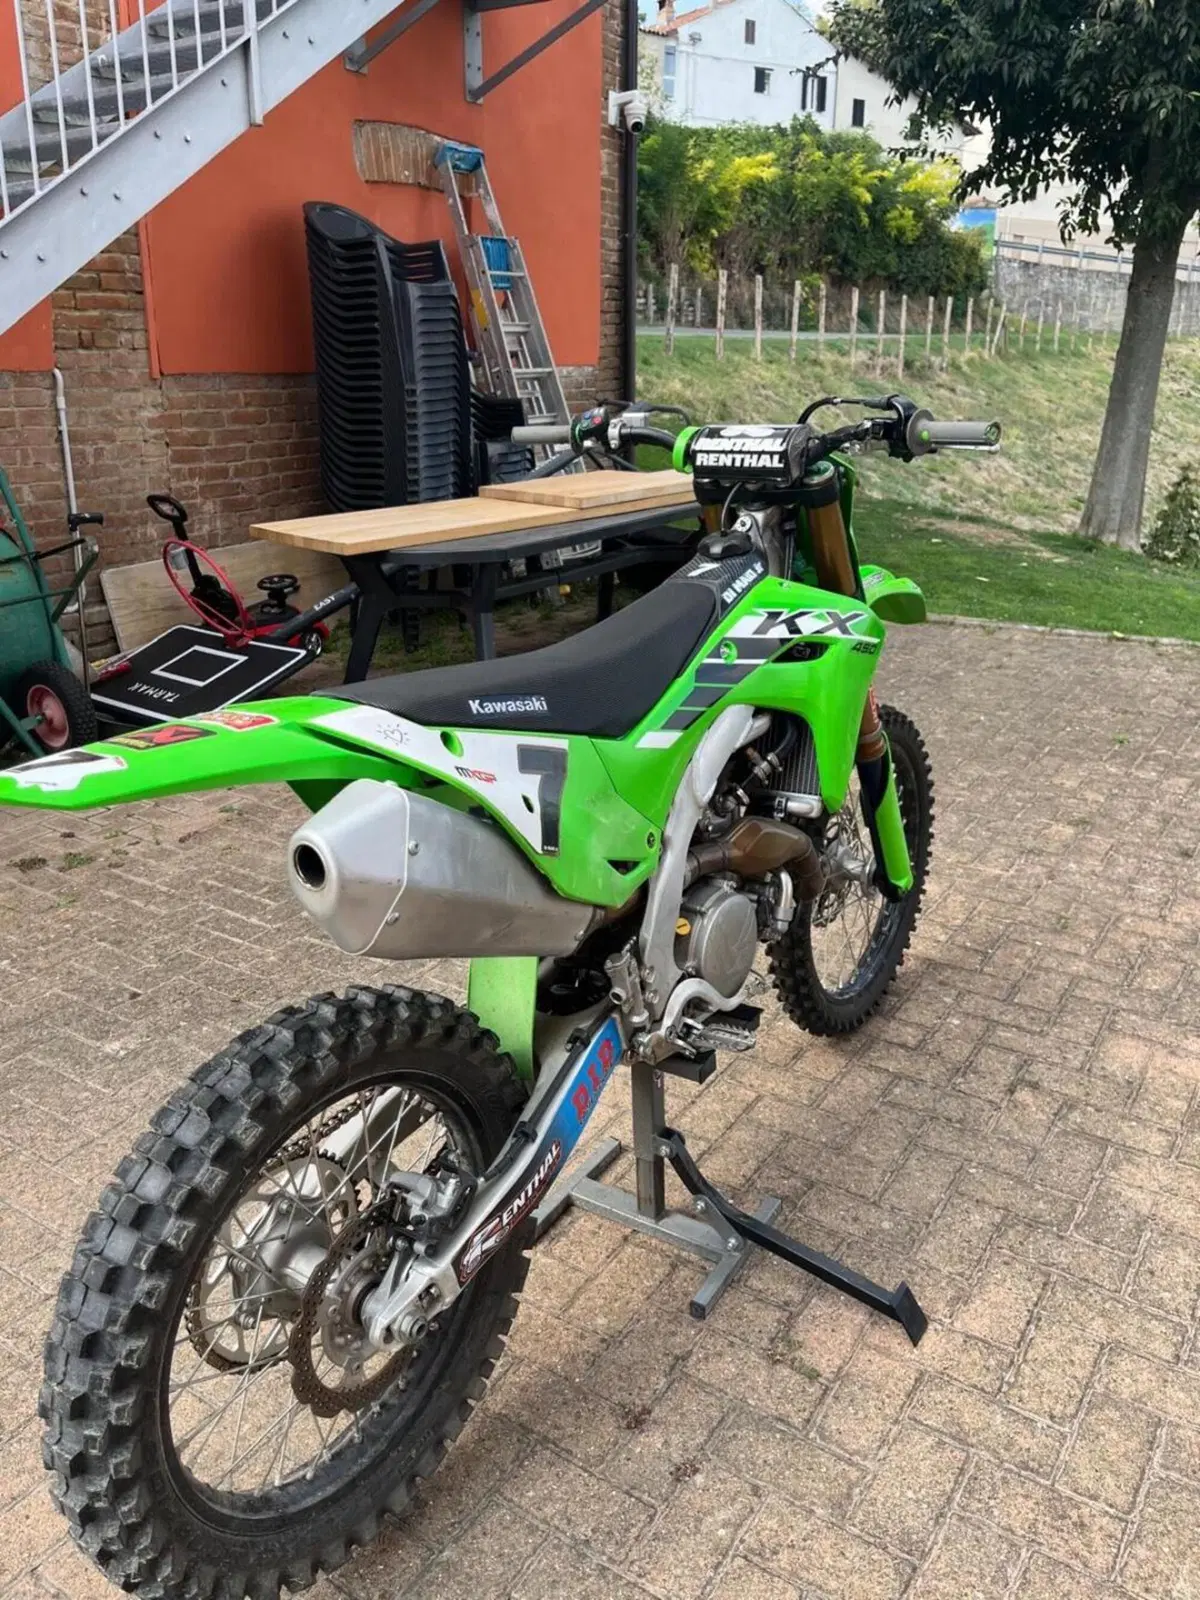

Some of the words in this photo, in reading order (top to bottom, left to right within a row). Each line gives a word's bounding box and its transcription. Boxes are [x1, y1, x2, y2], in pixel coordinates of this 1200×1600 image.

[696, 453, 784, 468] RENTHAL
[752, 610, 868, 636] KX
[127, 682, 180, 702] TARMAK
[469, 697, 548, 715] Kawasaki
